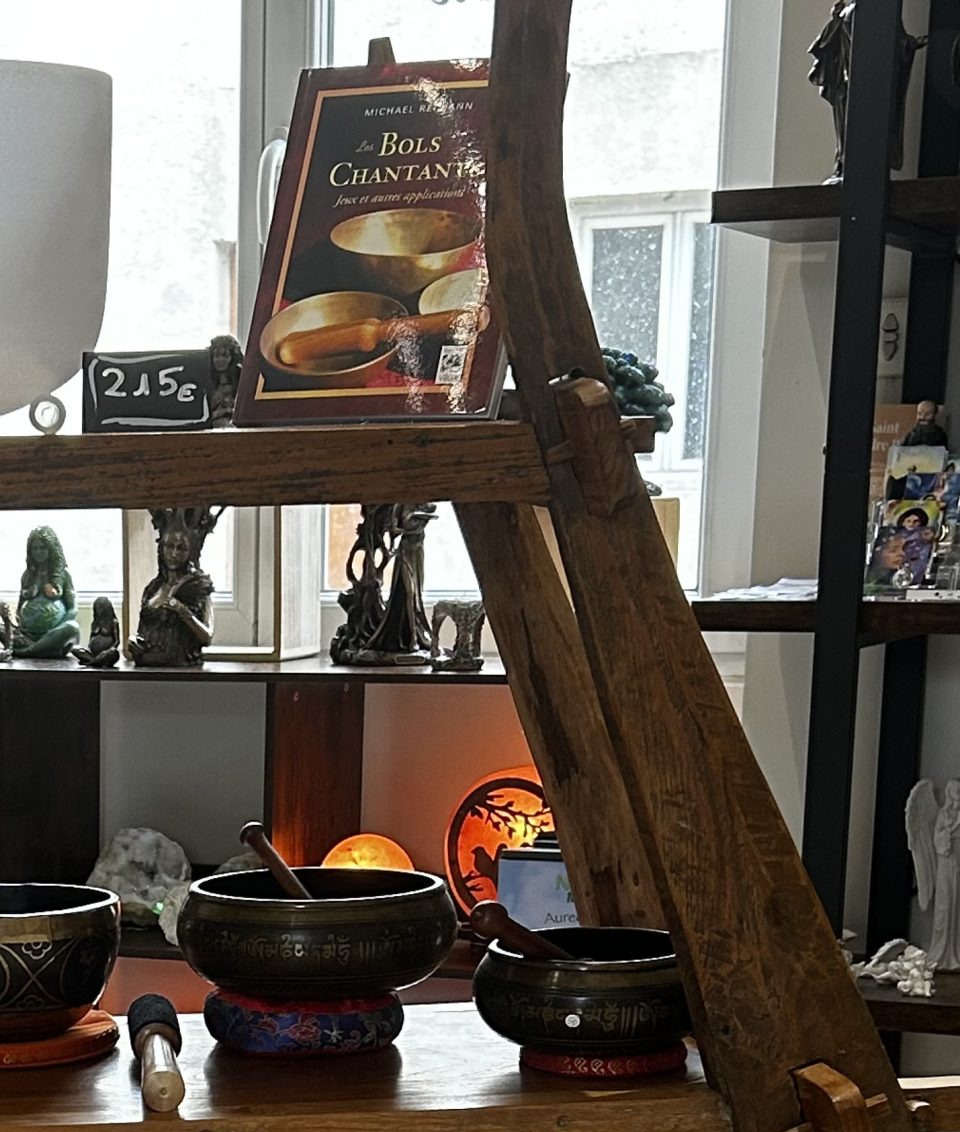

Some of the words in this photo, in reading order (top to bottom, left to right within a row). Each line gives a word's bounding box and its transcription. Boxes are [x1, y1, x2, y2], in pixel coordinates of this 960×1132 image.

[364, 105, 414, 117] MICHAEL
[356, 140, 375, 153] Les
[378, 132, 442, 157] BOLS
[329, 160, 485, 187] CHANTANT
[334, 195, 358, 208] Jeux
[359, 194, 370, 204] et
[371, 193, 400, 203] autres
[402, 188, 464, 204] applications
